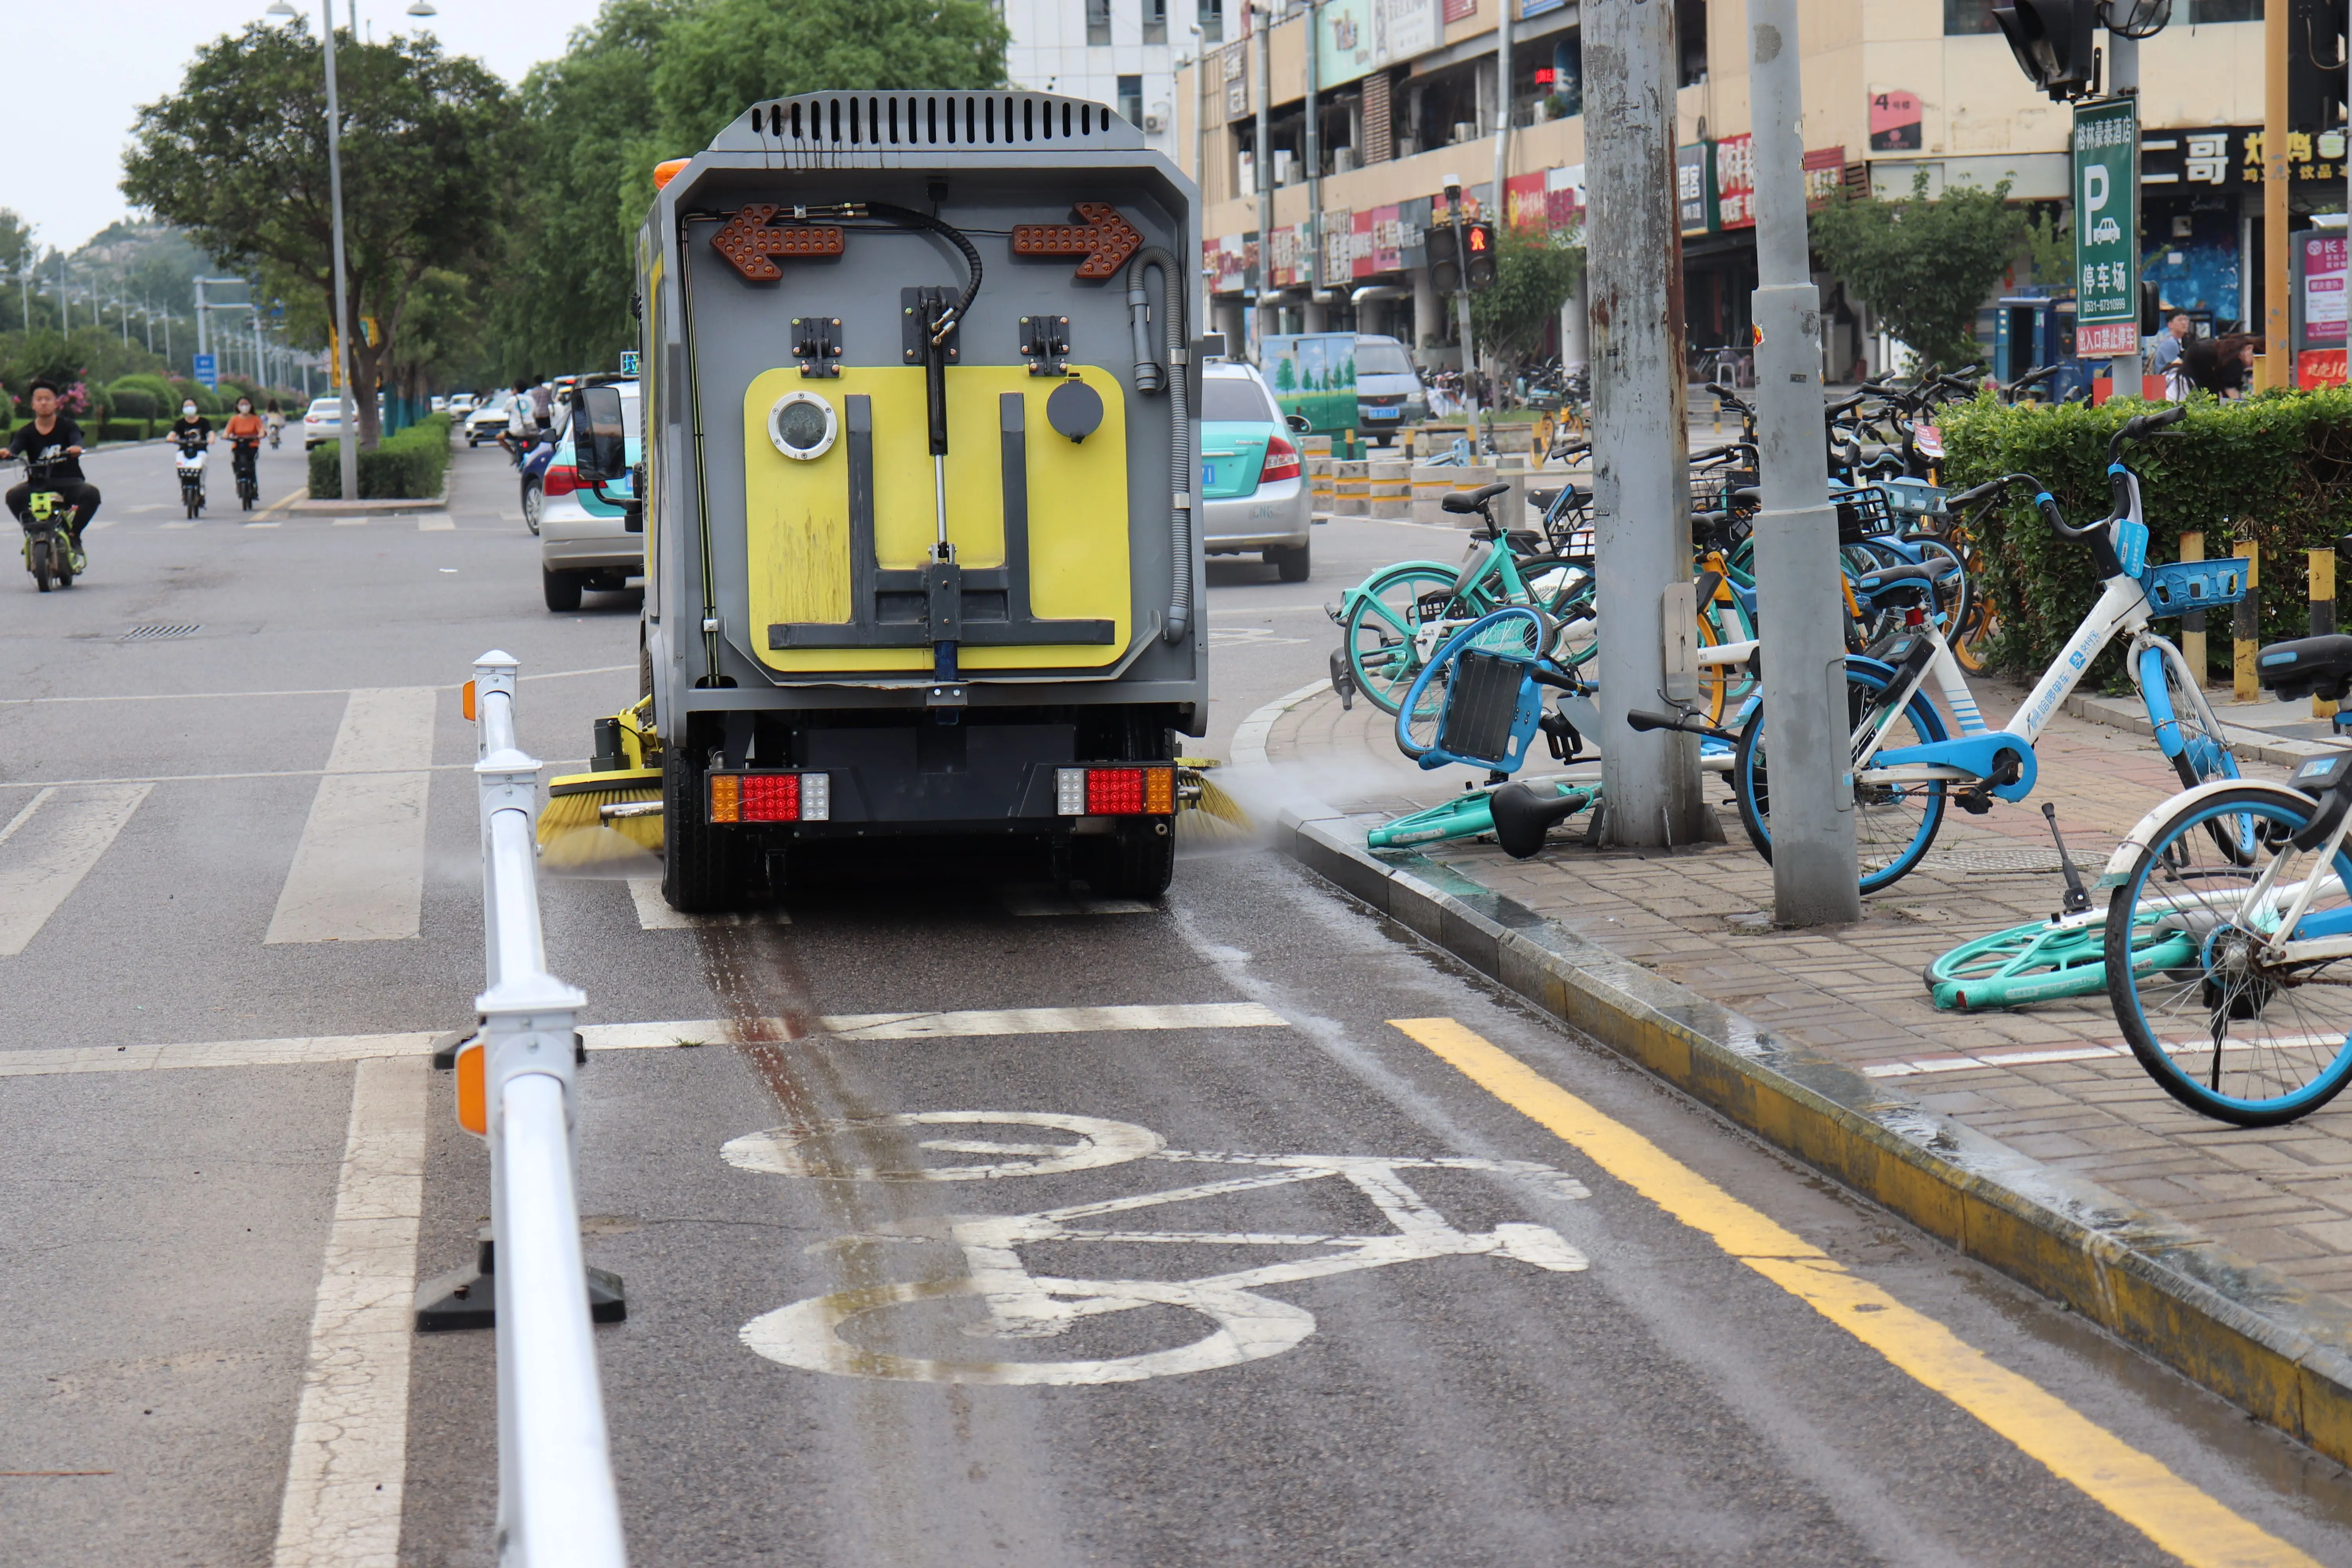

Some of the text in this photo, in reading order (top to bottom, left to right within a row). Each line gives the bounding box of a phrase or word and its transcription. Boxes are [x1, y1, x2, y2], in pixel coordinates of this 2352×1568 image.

[2077, 115, 2131, 151] 格林豪泰酒店
[2084, 164, 2109, 246] P
[2083, 261, 2126, 295] 停车场
[2084, 298, 2125, 313] 0531-87310999
[2079, 325, 2134, 351] 出入口禁止停车
[1253, 505, 1273, 519] CNG
[2079, 630, 2099, 653] 支付宝
[2038, 671, 2070, 715] 哈啰单车
